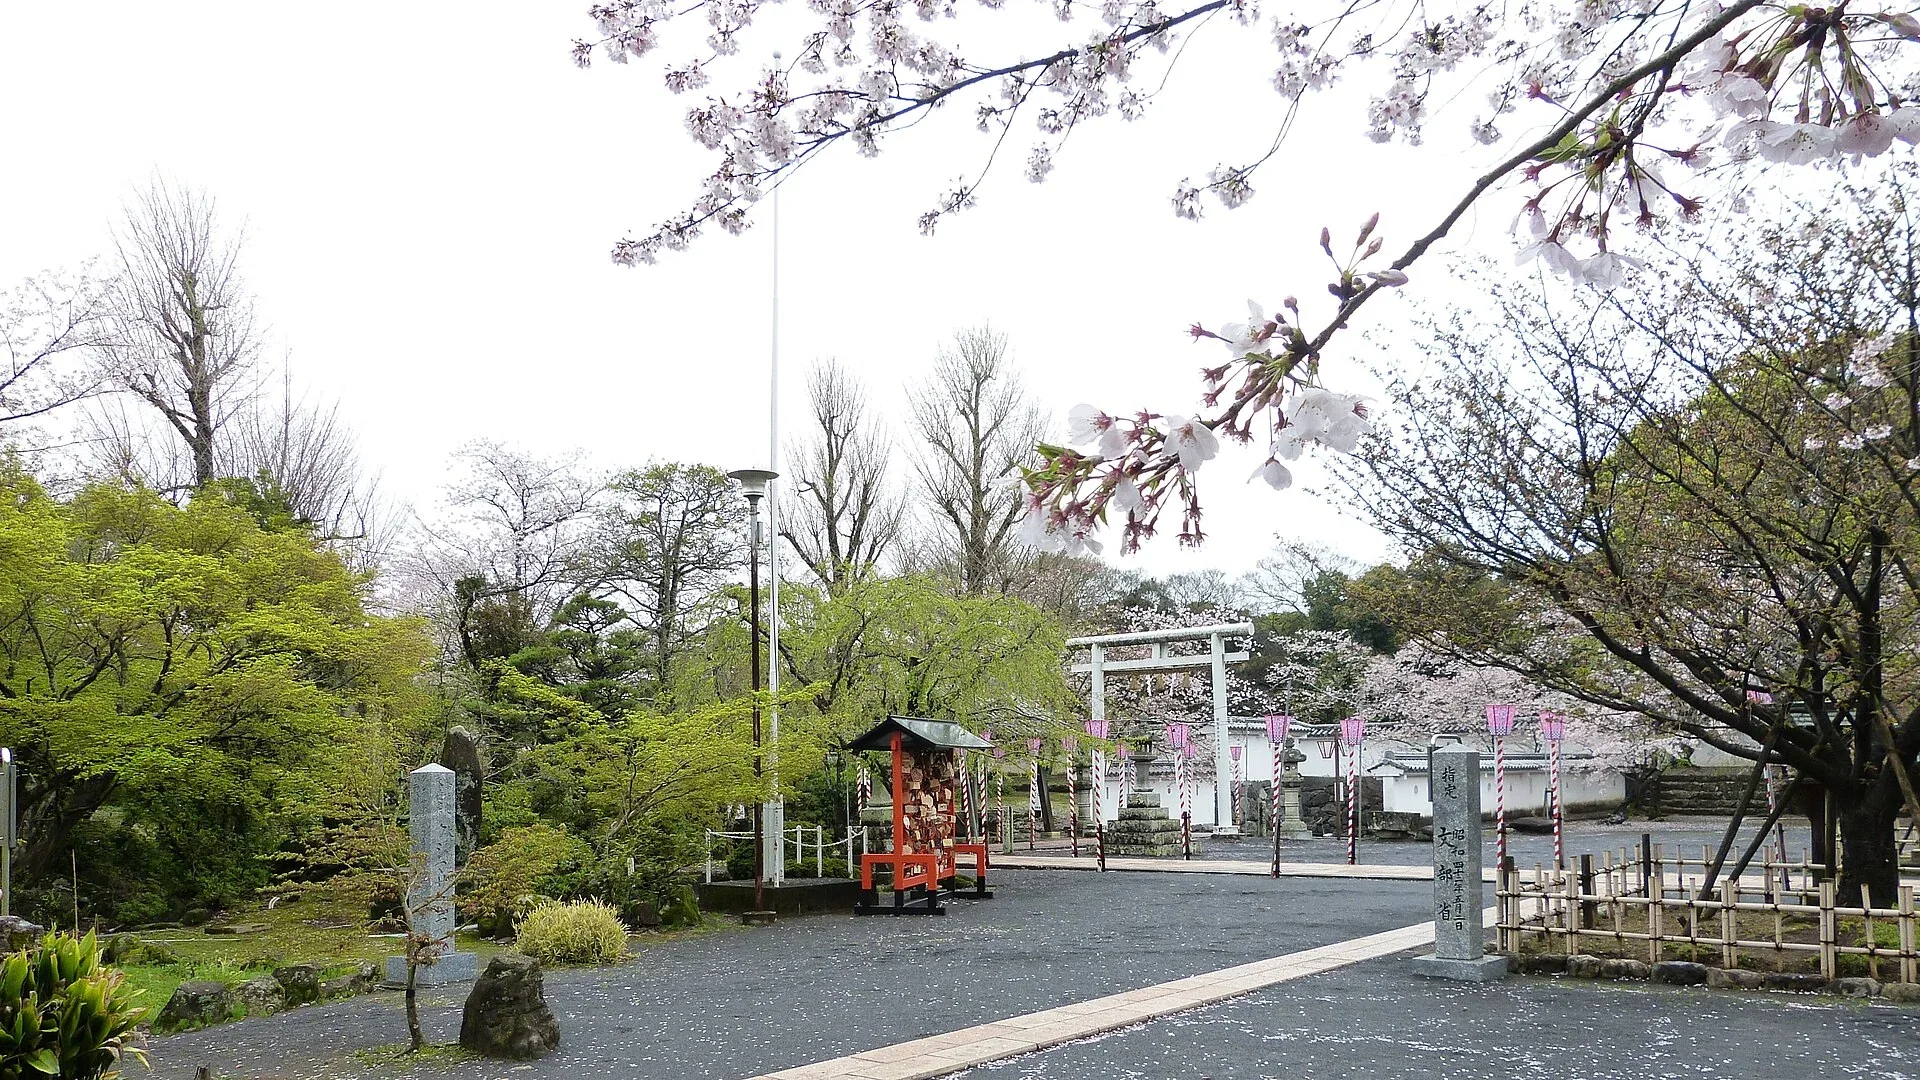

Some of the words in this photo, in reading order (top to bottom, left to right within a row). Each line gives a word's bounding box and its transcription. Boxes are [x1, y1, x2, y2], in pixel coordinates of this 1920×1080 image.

[1441, 766, 1457, 799] 指定
[1437, 827, 1455, 921] 文部省
